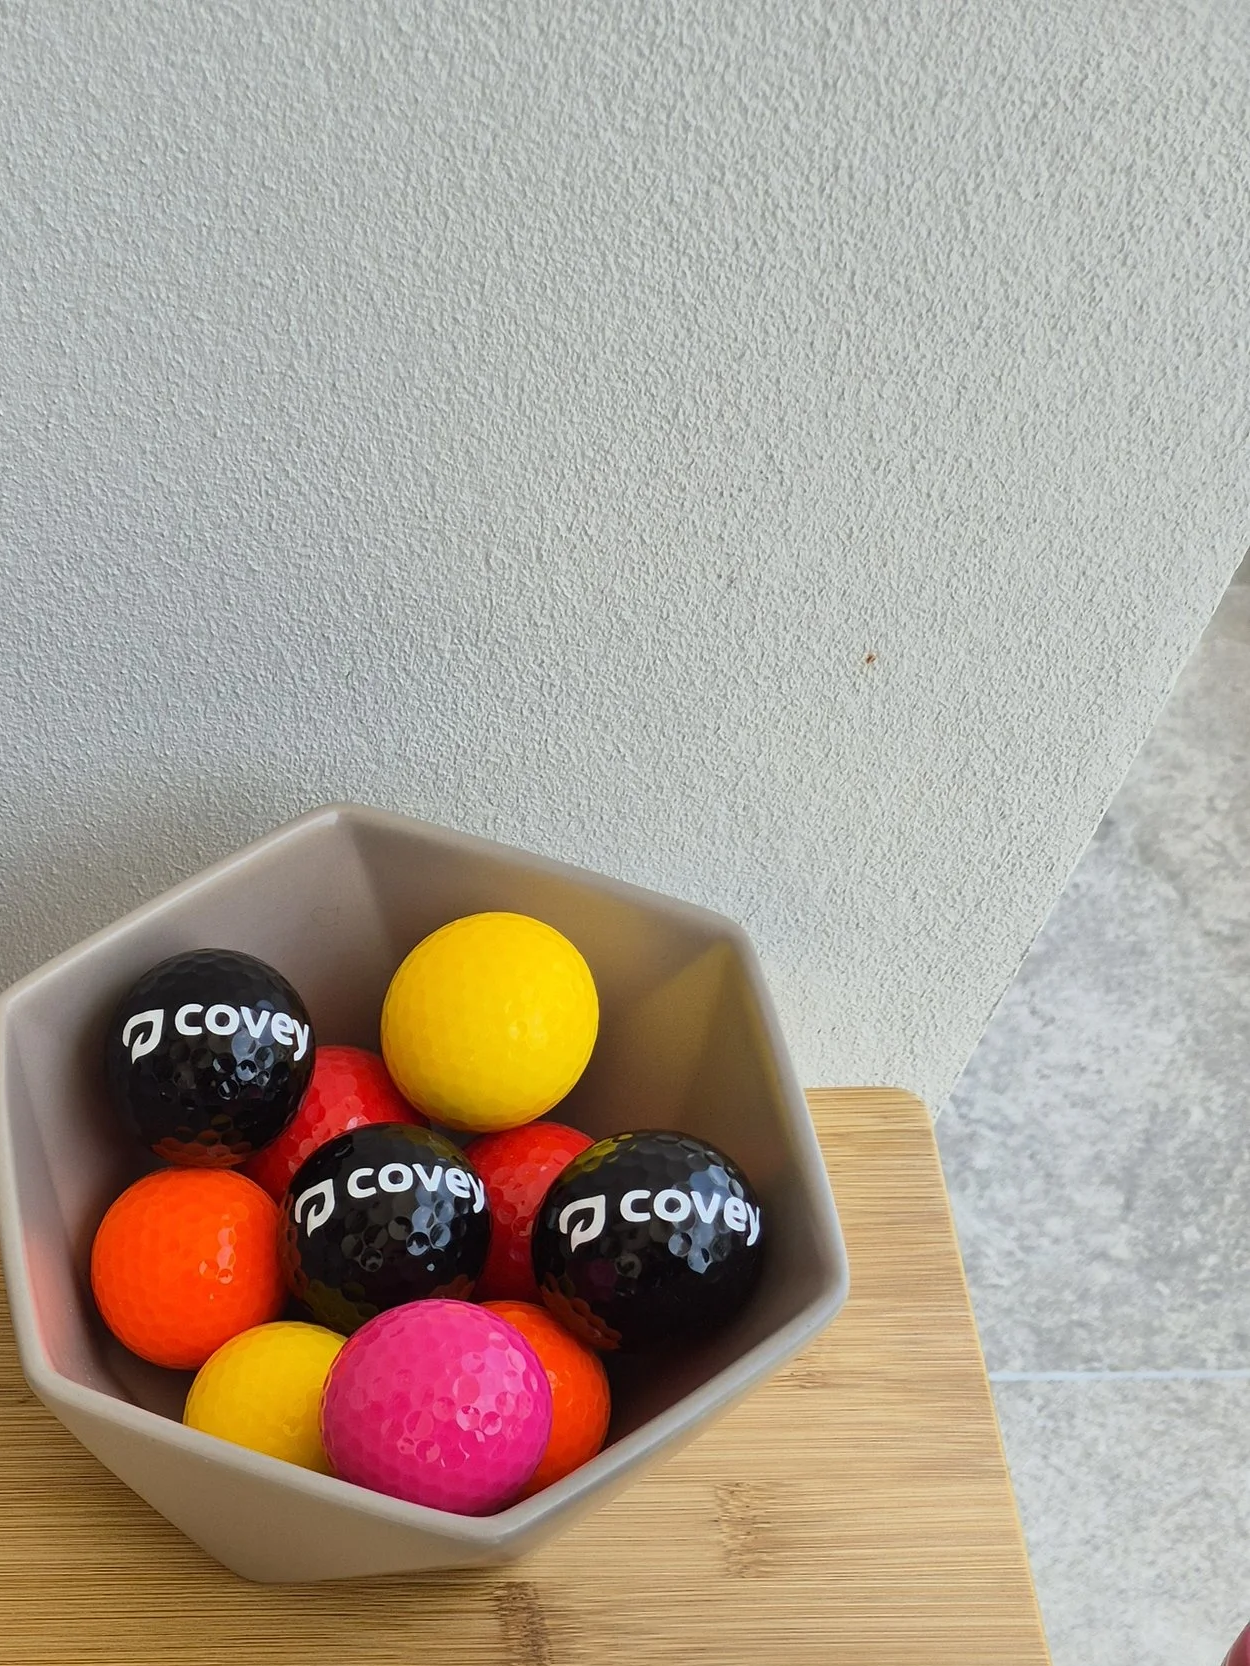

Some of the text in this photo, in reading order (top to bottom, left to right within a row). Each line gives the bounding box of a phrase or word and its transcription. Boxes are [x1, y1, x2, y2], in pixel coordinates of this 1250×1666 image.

[174, 1003, 310, 1062] covey
[346, 1162, 485, 1214] covey
[619, 1188, 761, 1247] covey
